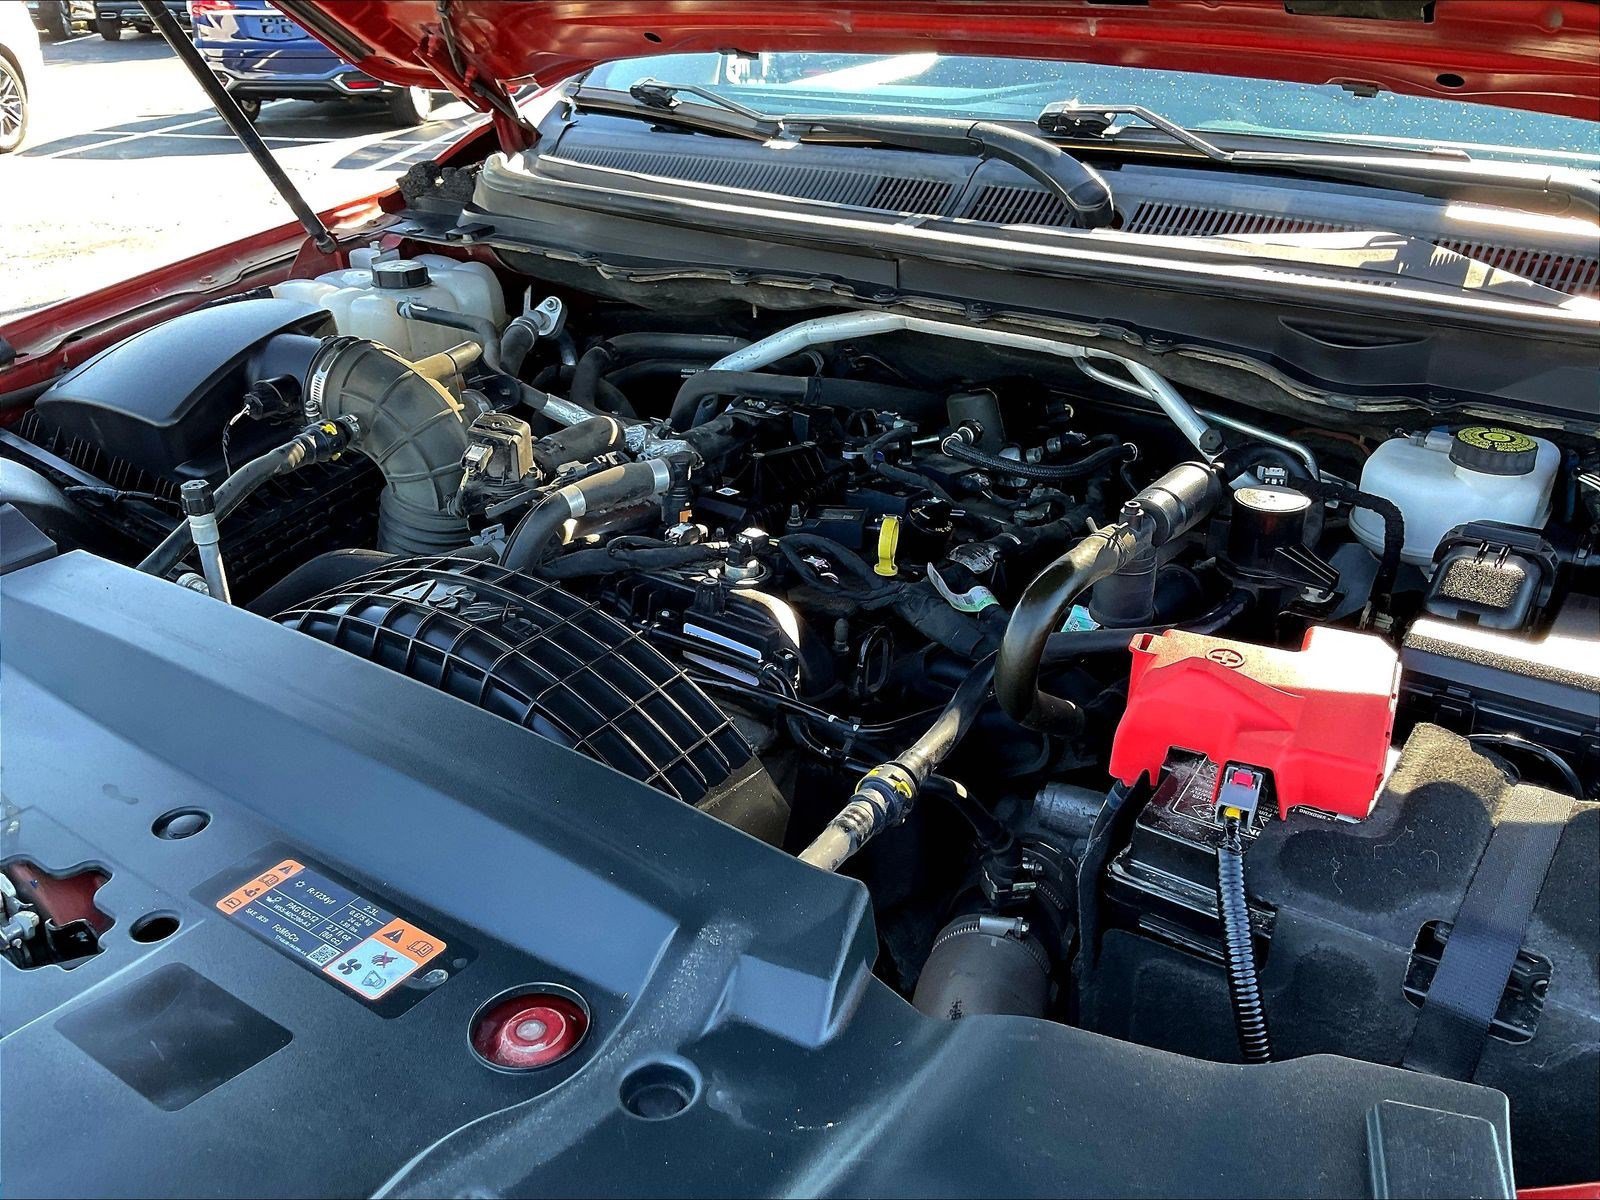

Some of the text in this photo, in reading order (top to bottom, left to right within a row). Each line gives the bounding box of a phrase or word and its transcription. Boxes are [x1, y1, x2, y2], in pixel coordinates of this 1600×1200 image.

[306, 887, 336, 905] R-1234yf
[245, 907, 256, 916] SAE
[286, 901, 319, 922] PAG ND-12
[363, 905, 379, 916] 2.3L
[364, 918, 373, 926] kg
[271, 924, 299, 942] FoMoCo
[325, 924, 338, 932] 2.7
[330, 937, 343, 946] cc)
